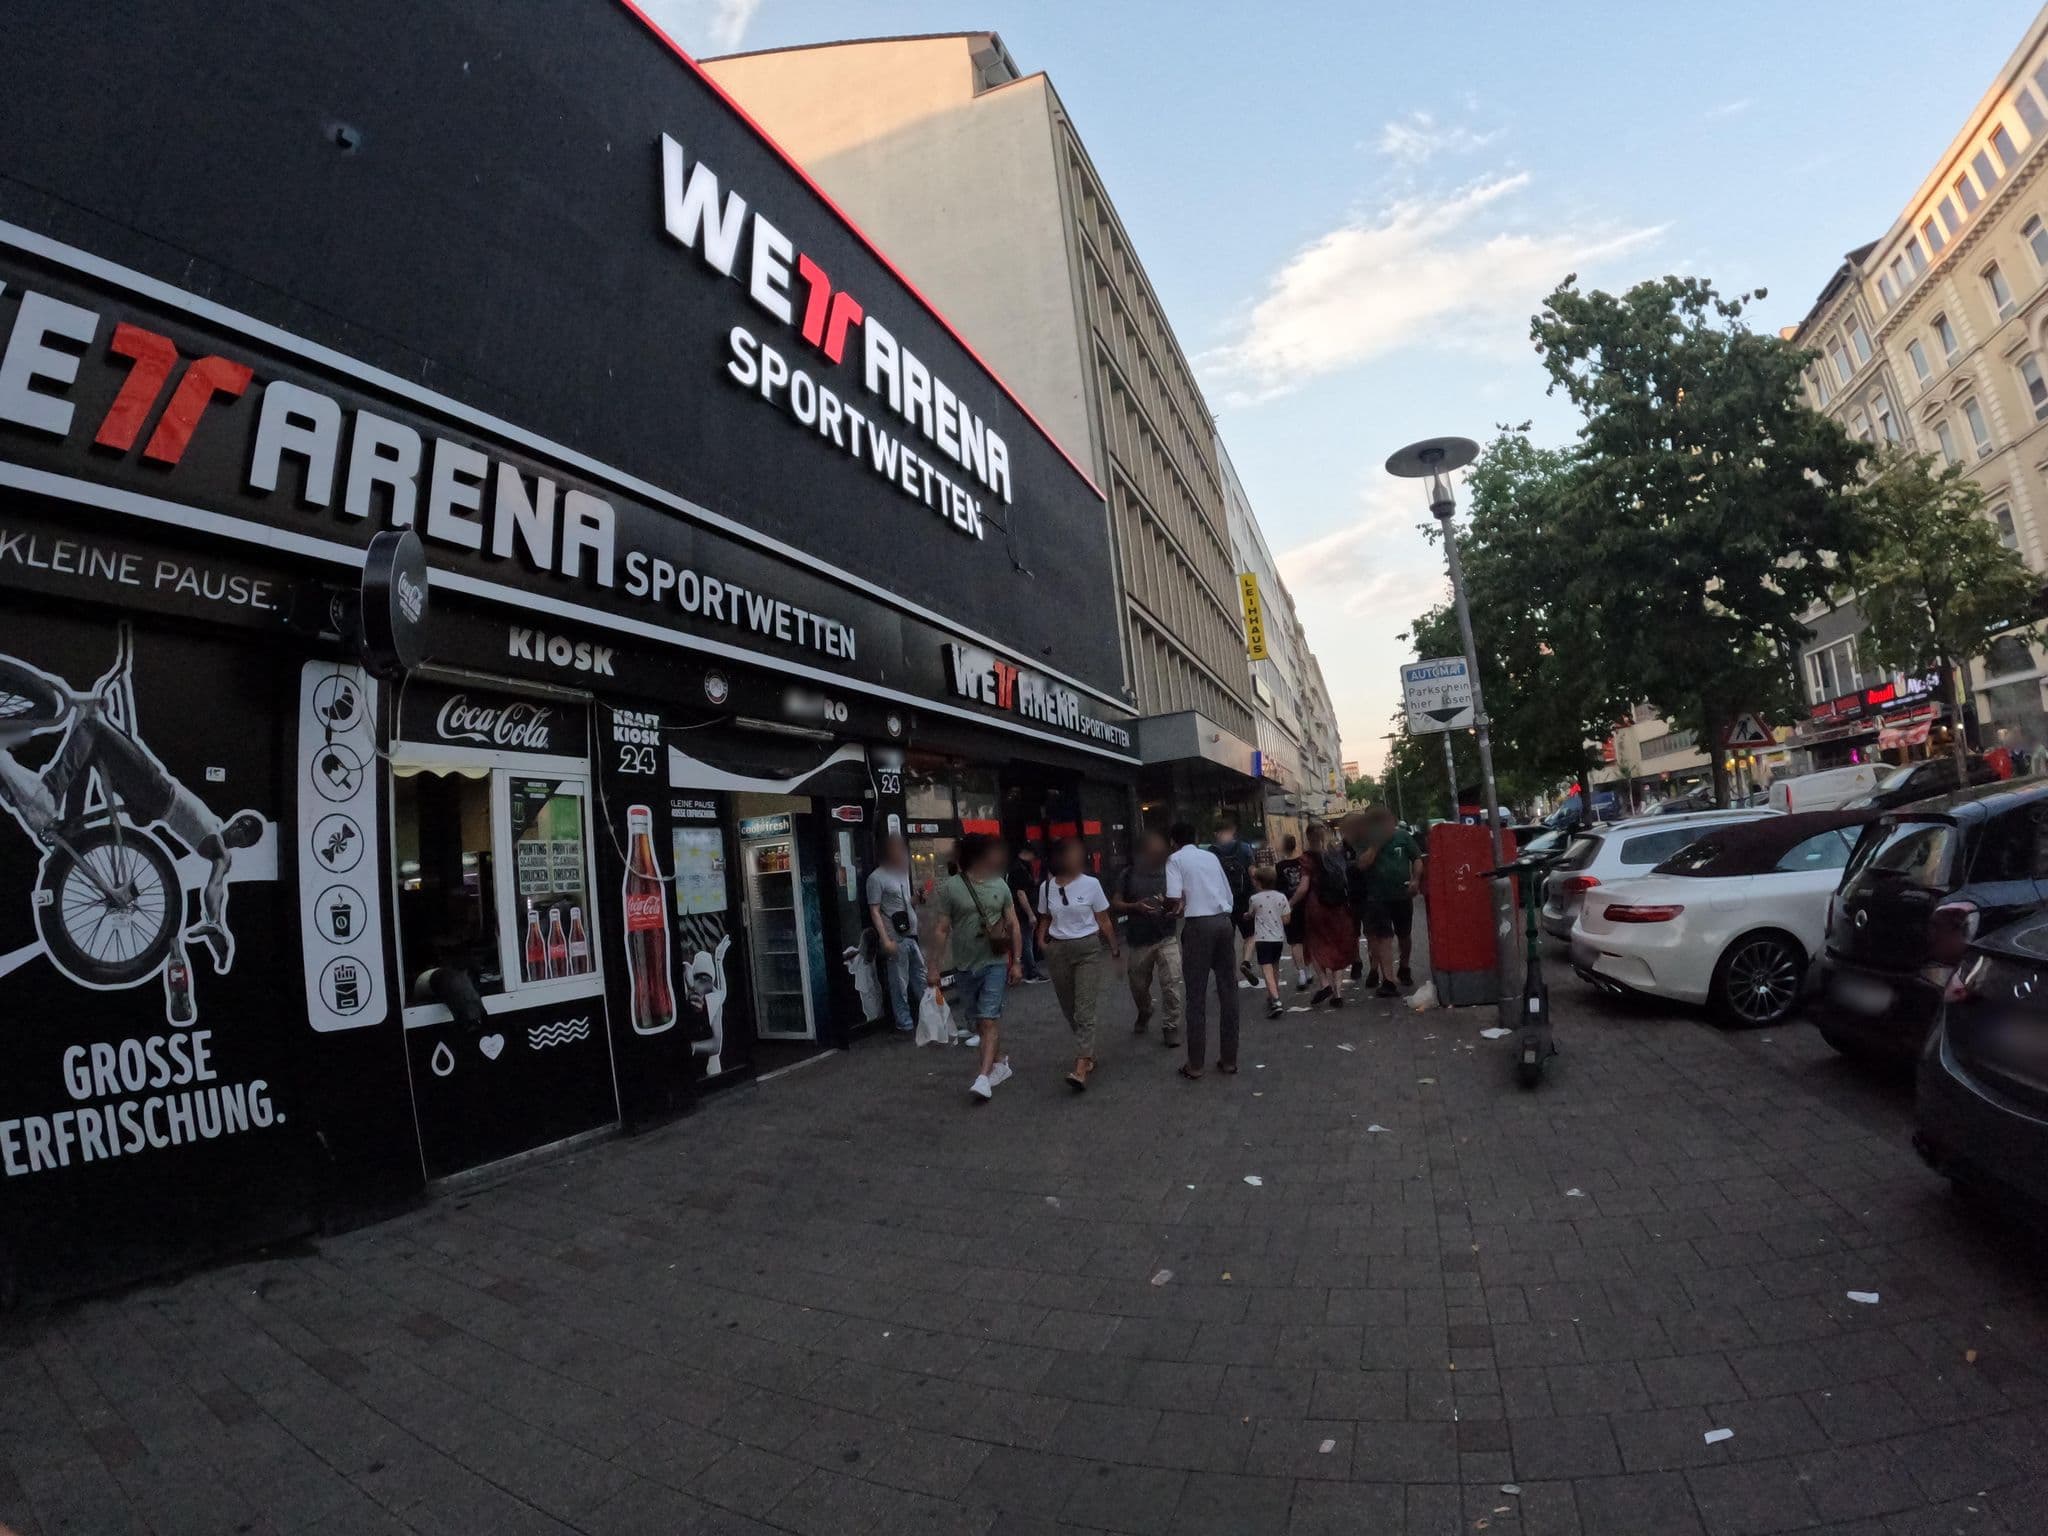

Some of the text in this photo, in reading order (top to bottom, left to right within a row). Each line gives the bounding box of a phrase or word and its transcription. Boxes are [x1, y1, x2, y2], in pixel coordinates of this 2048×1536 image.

[727, 326, 983, 540] SPORTWETTEN
[0, 530, 278, 611] KLEINE PAUSE.
[624, 552, 857, 660] SPORTWETTEN
[1244, 580, 1262, 653] LEIHHAUS
[509, 627, 615, 676] KIOSK
[1408, 683, 1470, 697] Parkschein
[1411, 664, 1462, 680] AUTOMAT
[436, 694, 552, 749] Coca-Cola
[613, 709, 659, 730] KRAFT
[1411, 700, 1432, 709] hier
[613, 726, 660, 746] KIOSK
[1079, 715, 1130, 747] SPORTWETTEN
[617, 745, 656, 774] 24
[882, 775, 900, 794] 24
[63, 1030, 217, 1100] GROSSE
[0, 1080, 286, 1177] ERFRISCHUNG.
